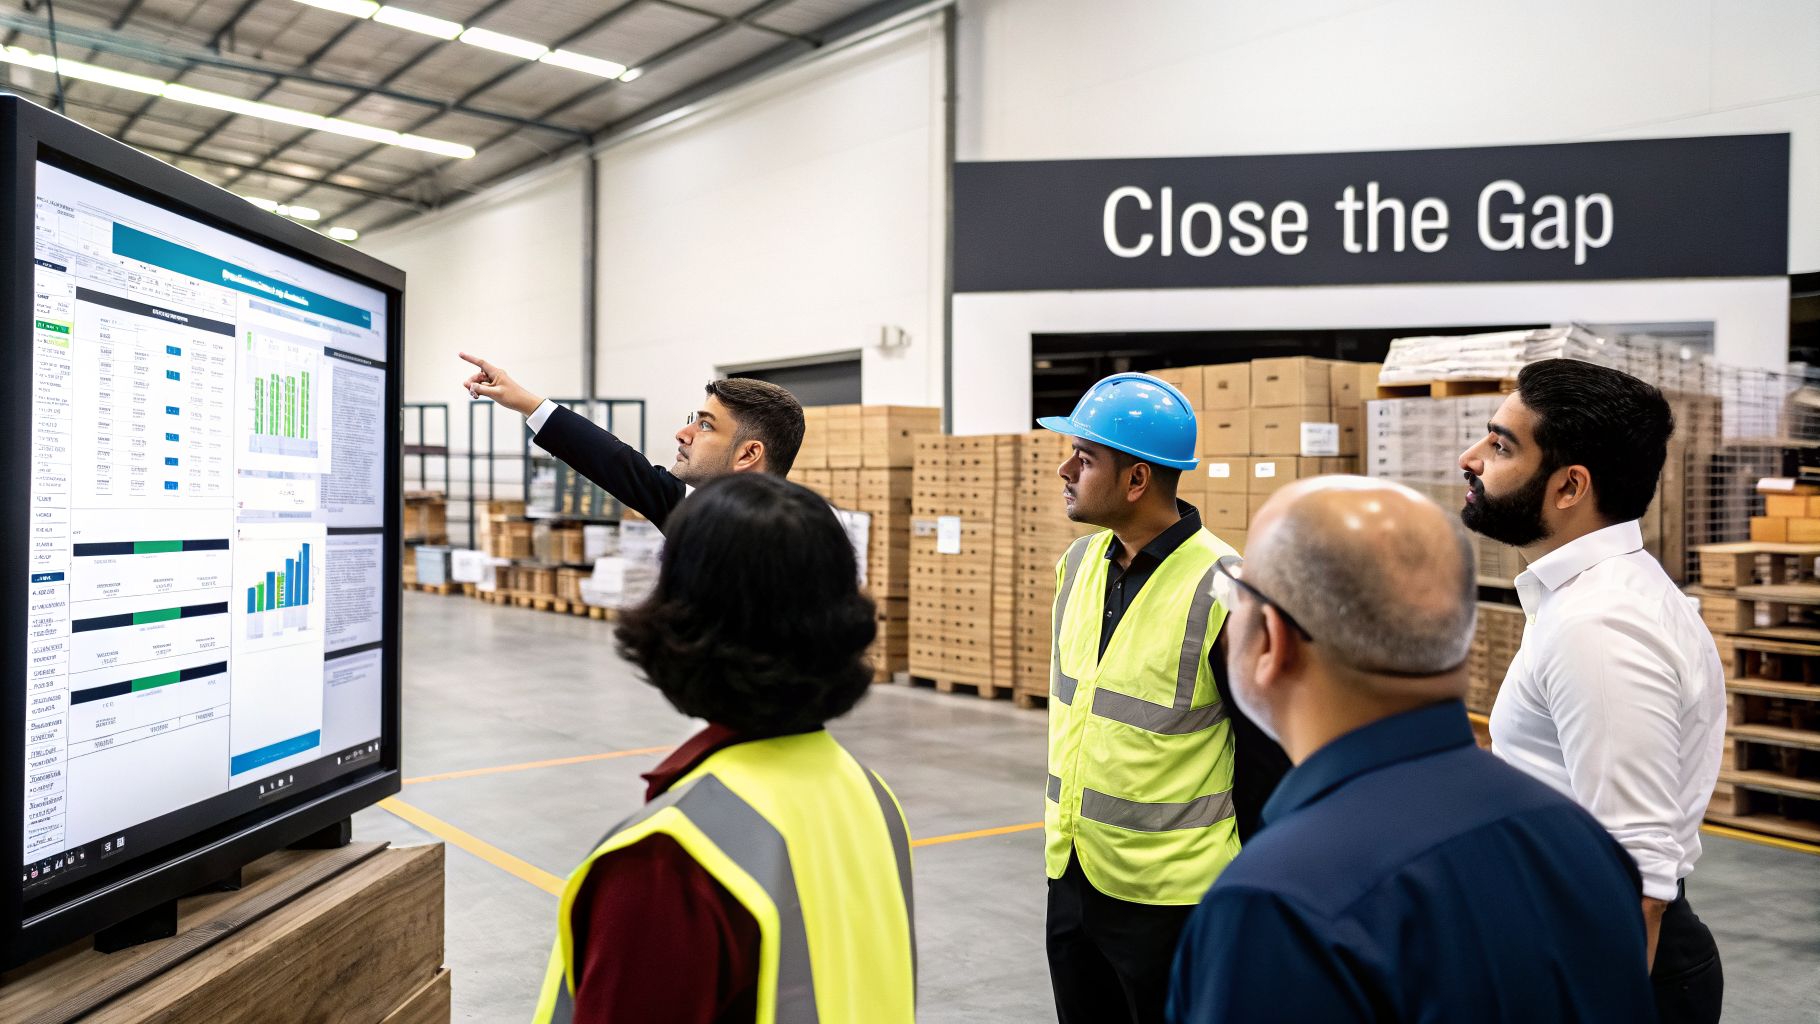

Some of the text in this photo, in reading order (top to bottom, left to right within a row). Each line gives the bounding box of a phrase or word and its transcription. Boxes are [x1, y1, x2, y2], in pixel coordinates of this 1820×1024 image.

[1102, 179, 1614, 266] Close the Gap
